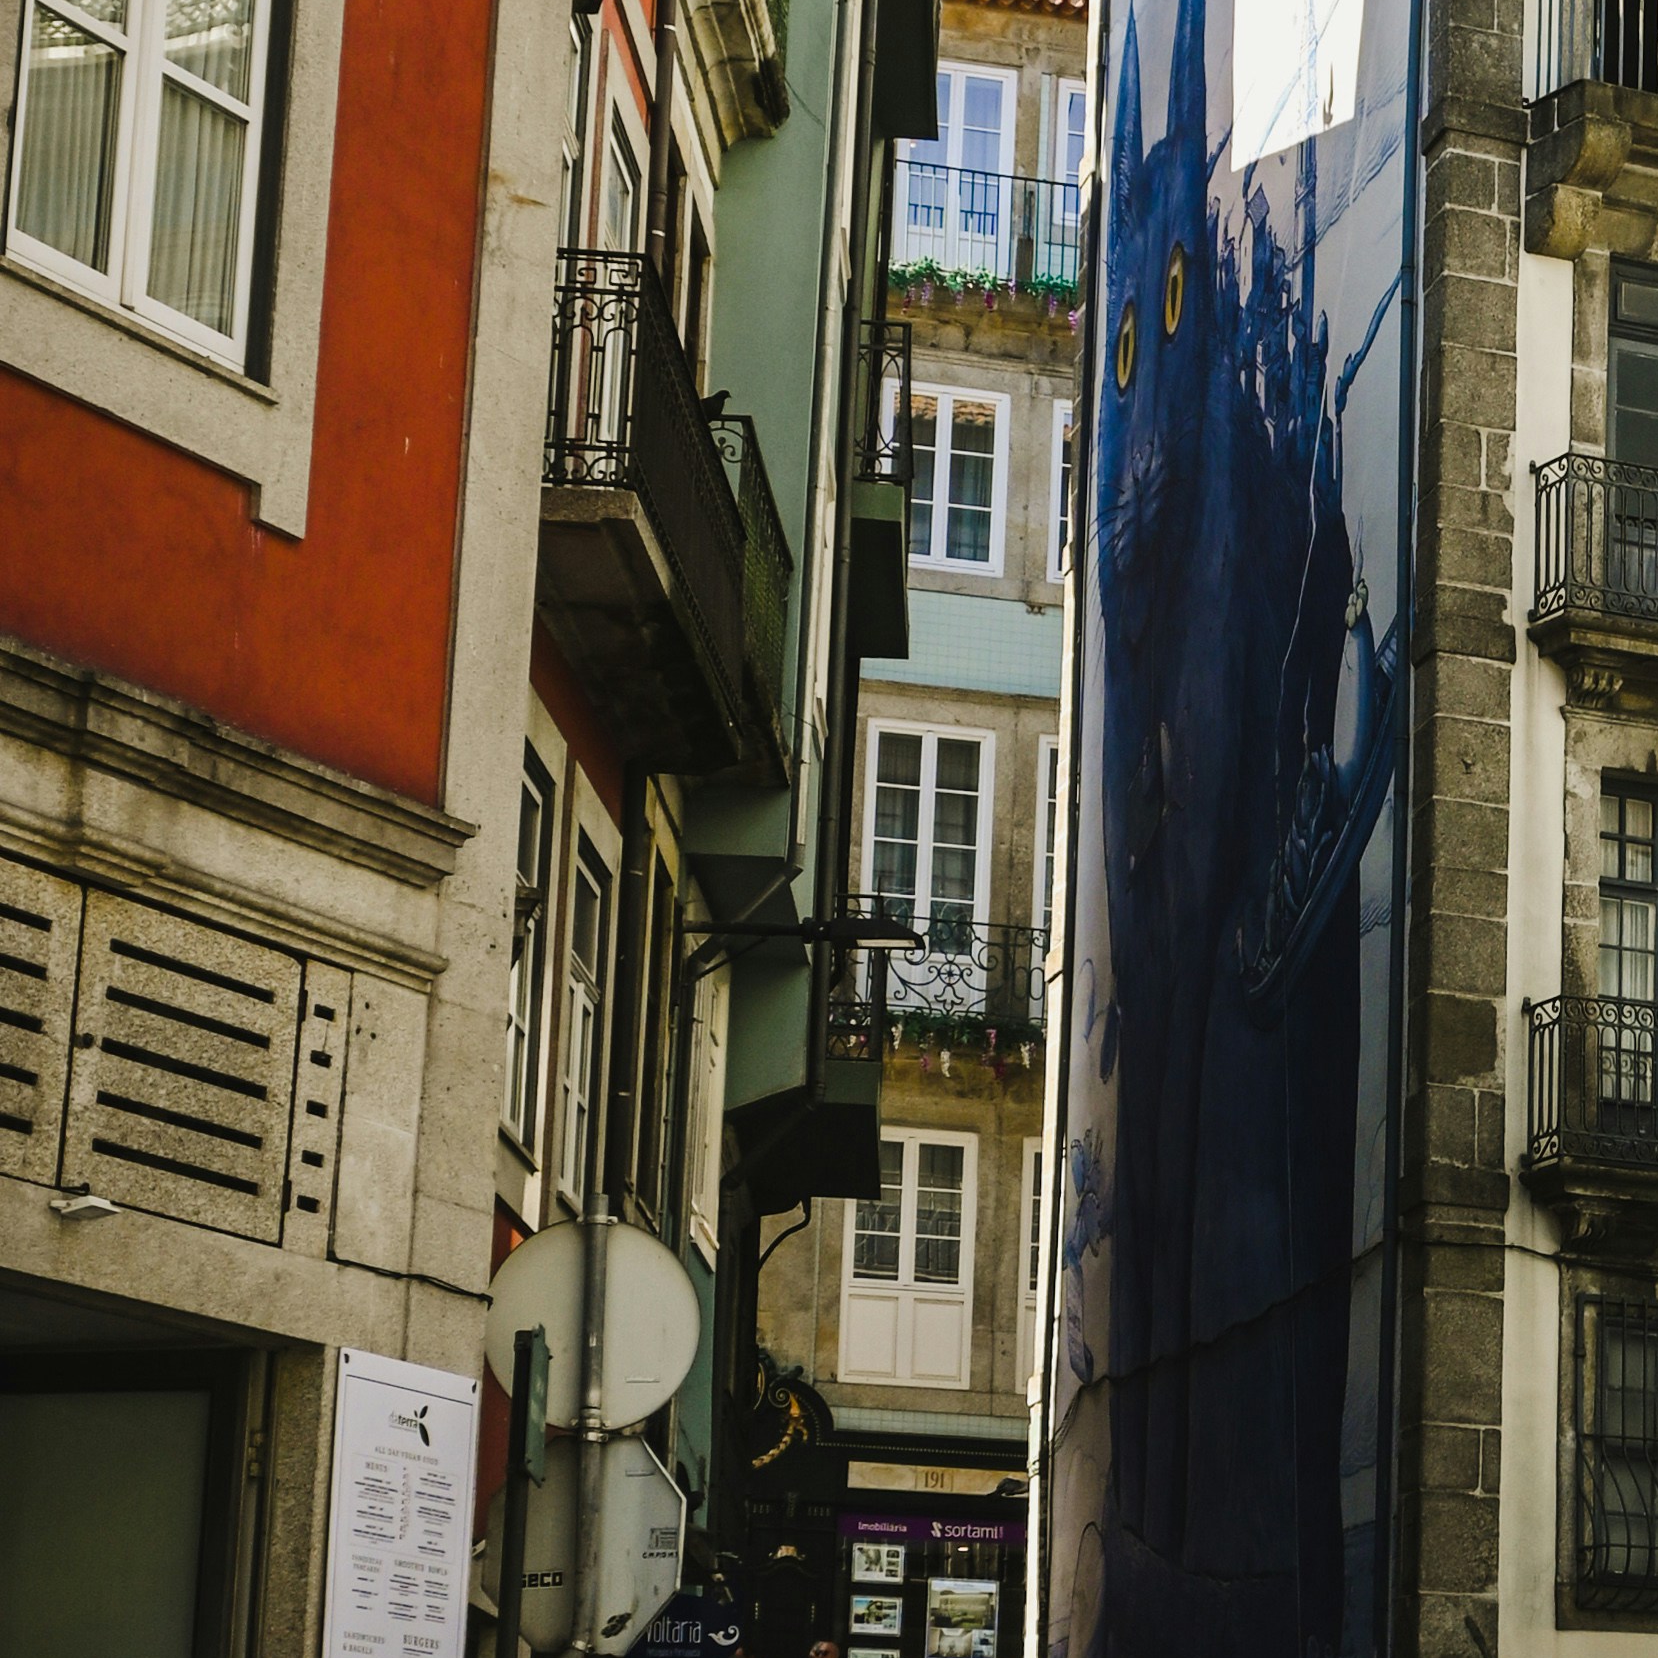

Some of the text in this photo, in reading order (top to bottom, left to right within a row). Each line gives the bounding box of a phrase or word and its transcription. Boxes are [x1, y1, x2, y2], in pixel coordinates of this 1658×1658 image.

[924, 1471, 944, 1489] 191
[944, 1522, 998, 1540] sortami
[403, 1634, 440, 1650] BURGERS
